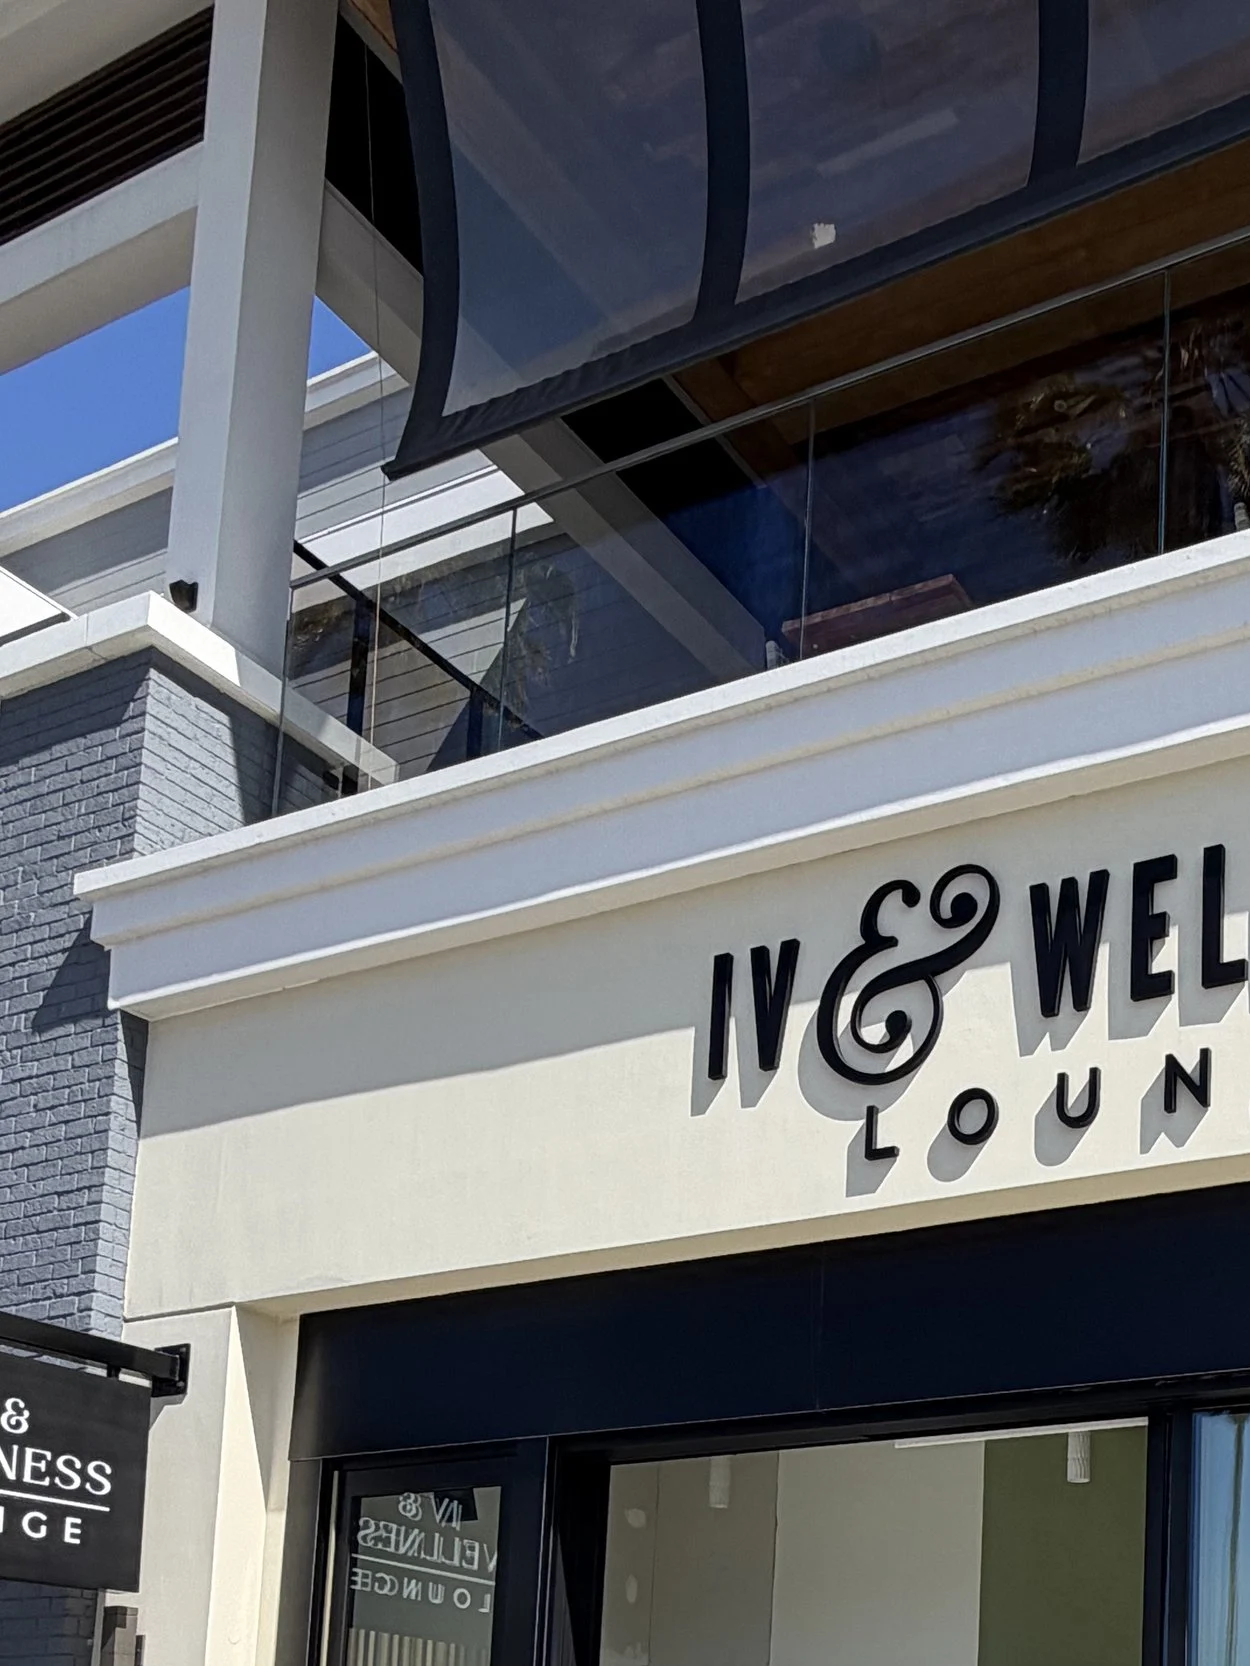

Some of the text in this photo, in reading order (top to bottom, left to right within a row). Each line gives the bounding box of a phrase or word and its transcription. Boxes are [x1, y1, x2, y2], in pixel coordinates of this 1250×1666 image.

[707, 937, 800, 1081] IV
[817, 863, 1000, 1085] &
[0, 1397, 30, 1434] &
